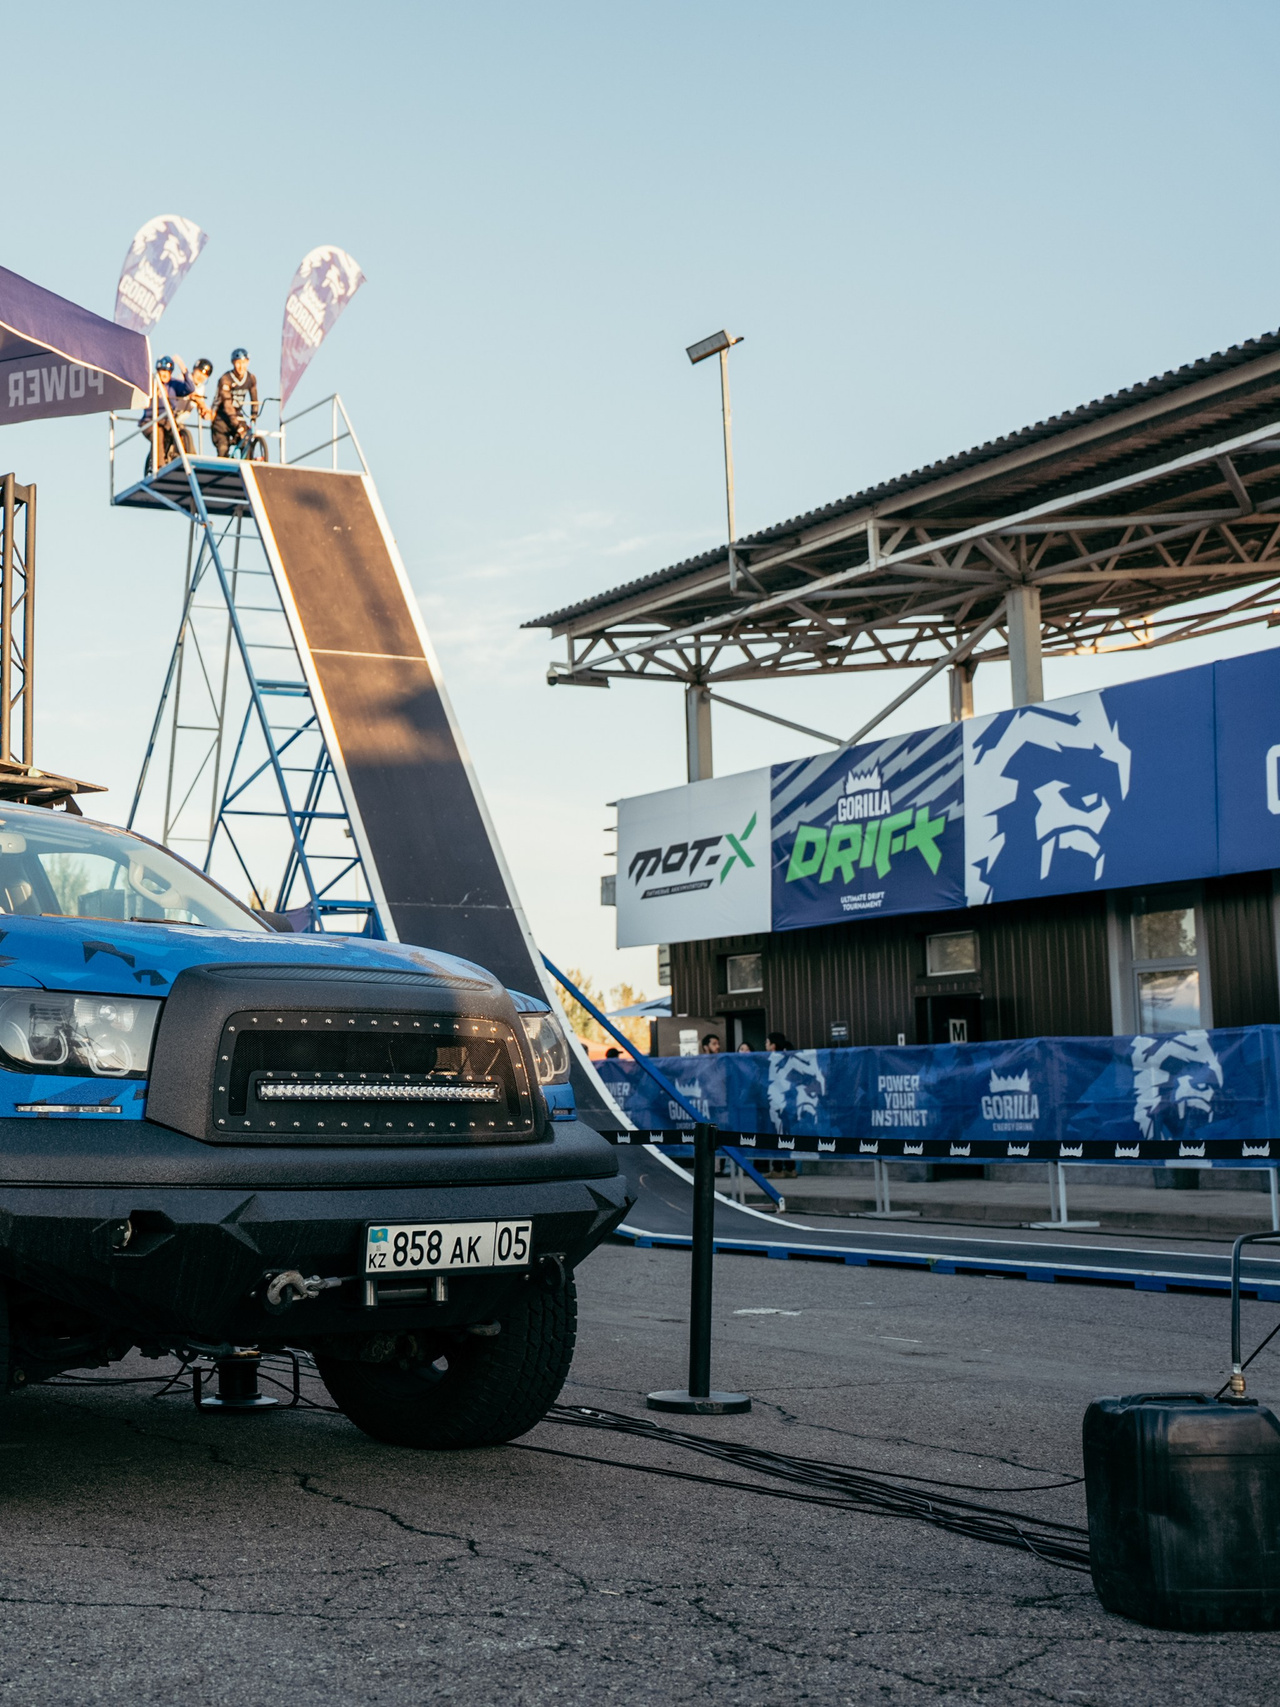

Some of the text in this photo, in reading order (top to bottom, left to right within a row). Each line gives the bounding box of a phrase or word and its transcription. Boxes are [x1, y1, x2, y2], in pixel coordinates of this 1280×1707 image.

[119, 274, 165, 324] GORILLA
[286, 294, 323, 347] GORILLA
[837, 790, 891, 822] GORILLA
[840, 891, 885, 904] ULTIMATE DRIFT
[842, 900, 882, 911] TOURNAMENT
[878, 1075, 920, 1092] POWER
[884, 1092, 915, 1110] YOUR
[981, 1094, 1039, 1120] GORILLA
[871, 1110, 928, 1127] INSTINCT
[369, 1226, 529, 1269] KZ 858 AK 05
